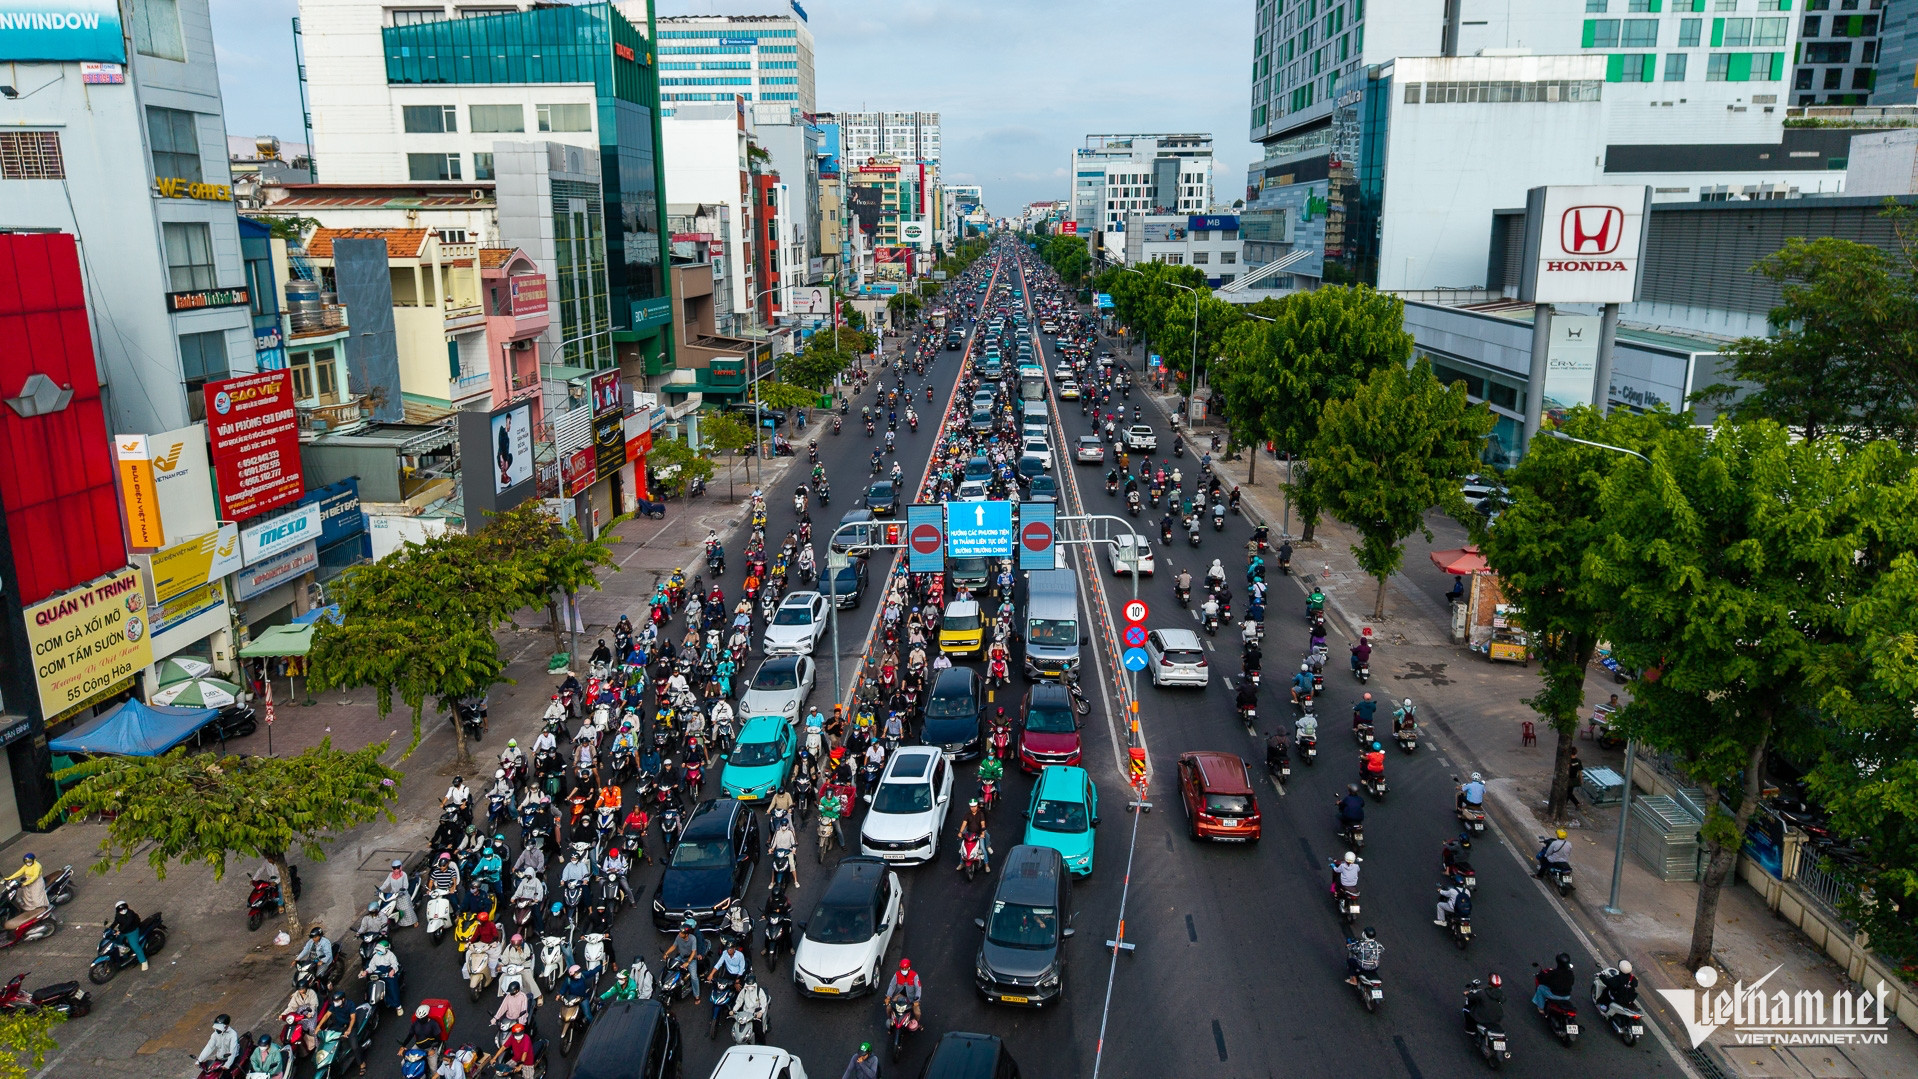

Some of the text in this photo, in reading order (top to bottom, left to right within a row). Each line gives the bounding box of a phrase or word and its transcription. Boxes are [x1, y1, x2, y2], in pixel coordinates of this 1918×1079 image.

[1546, 261, 1628, 272] HONDA
[230, 381, 282, 402] SAO VIỆT
[1623, 385, 1644, 406] Cộng
[217, 409, 294, 436] VĂN PHÒNG GHI DANH
[542, 462, 558, 482] BUFFE
[330, 502, 344, 517] BIẾT
[344, 498, 359, 510] ĐỌC
[36, 597, 78, 626] QUÁN
[80, 590, 95, 608] YI
[96, 575, 137, 601] TRINH
[36, 607, 121, 656] CƠM GÀ XỐI MỠ
[40, 630, 125, 678] CƠM TẤM SƯỜN
[68, 663, 132, 701] 55 Cộng Hòa
